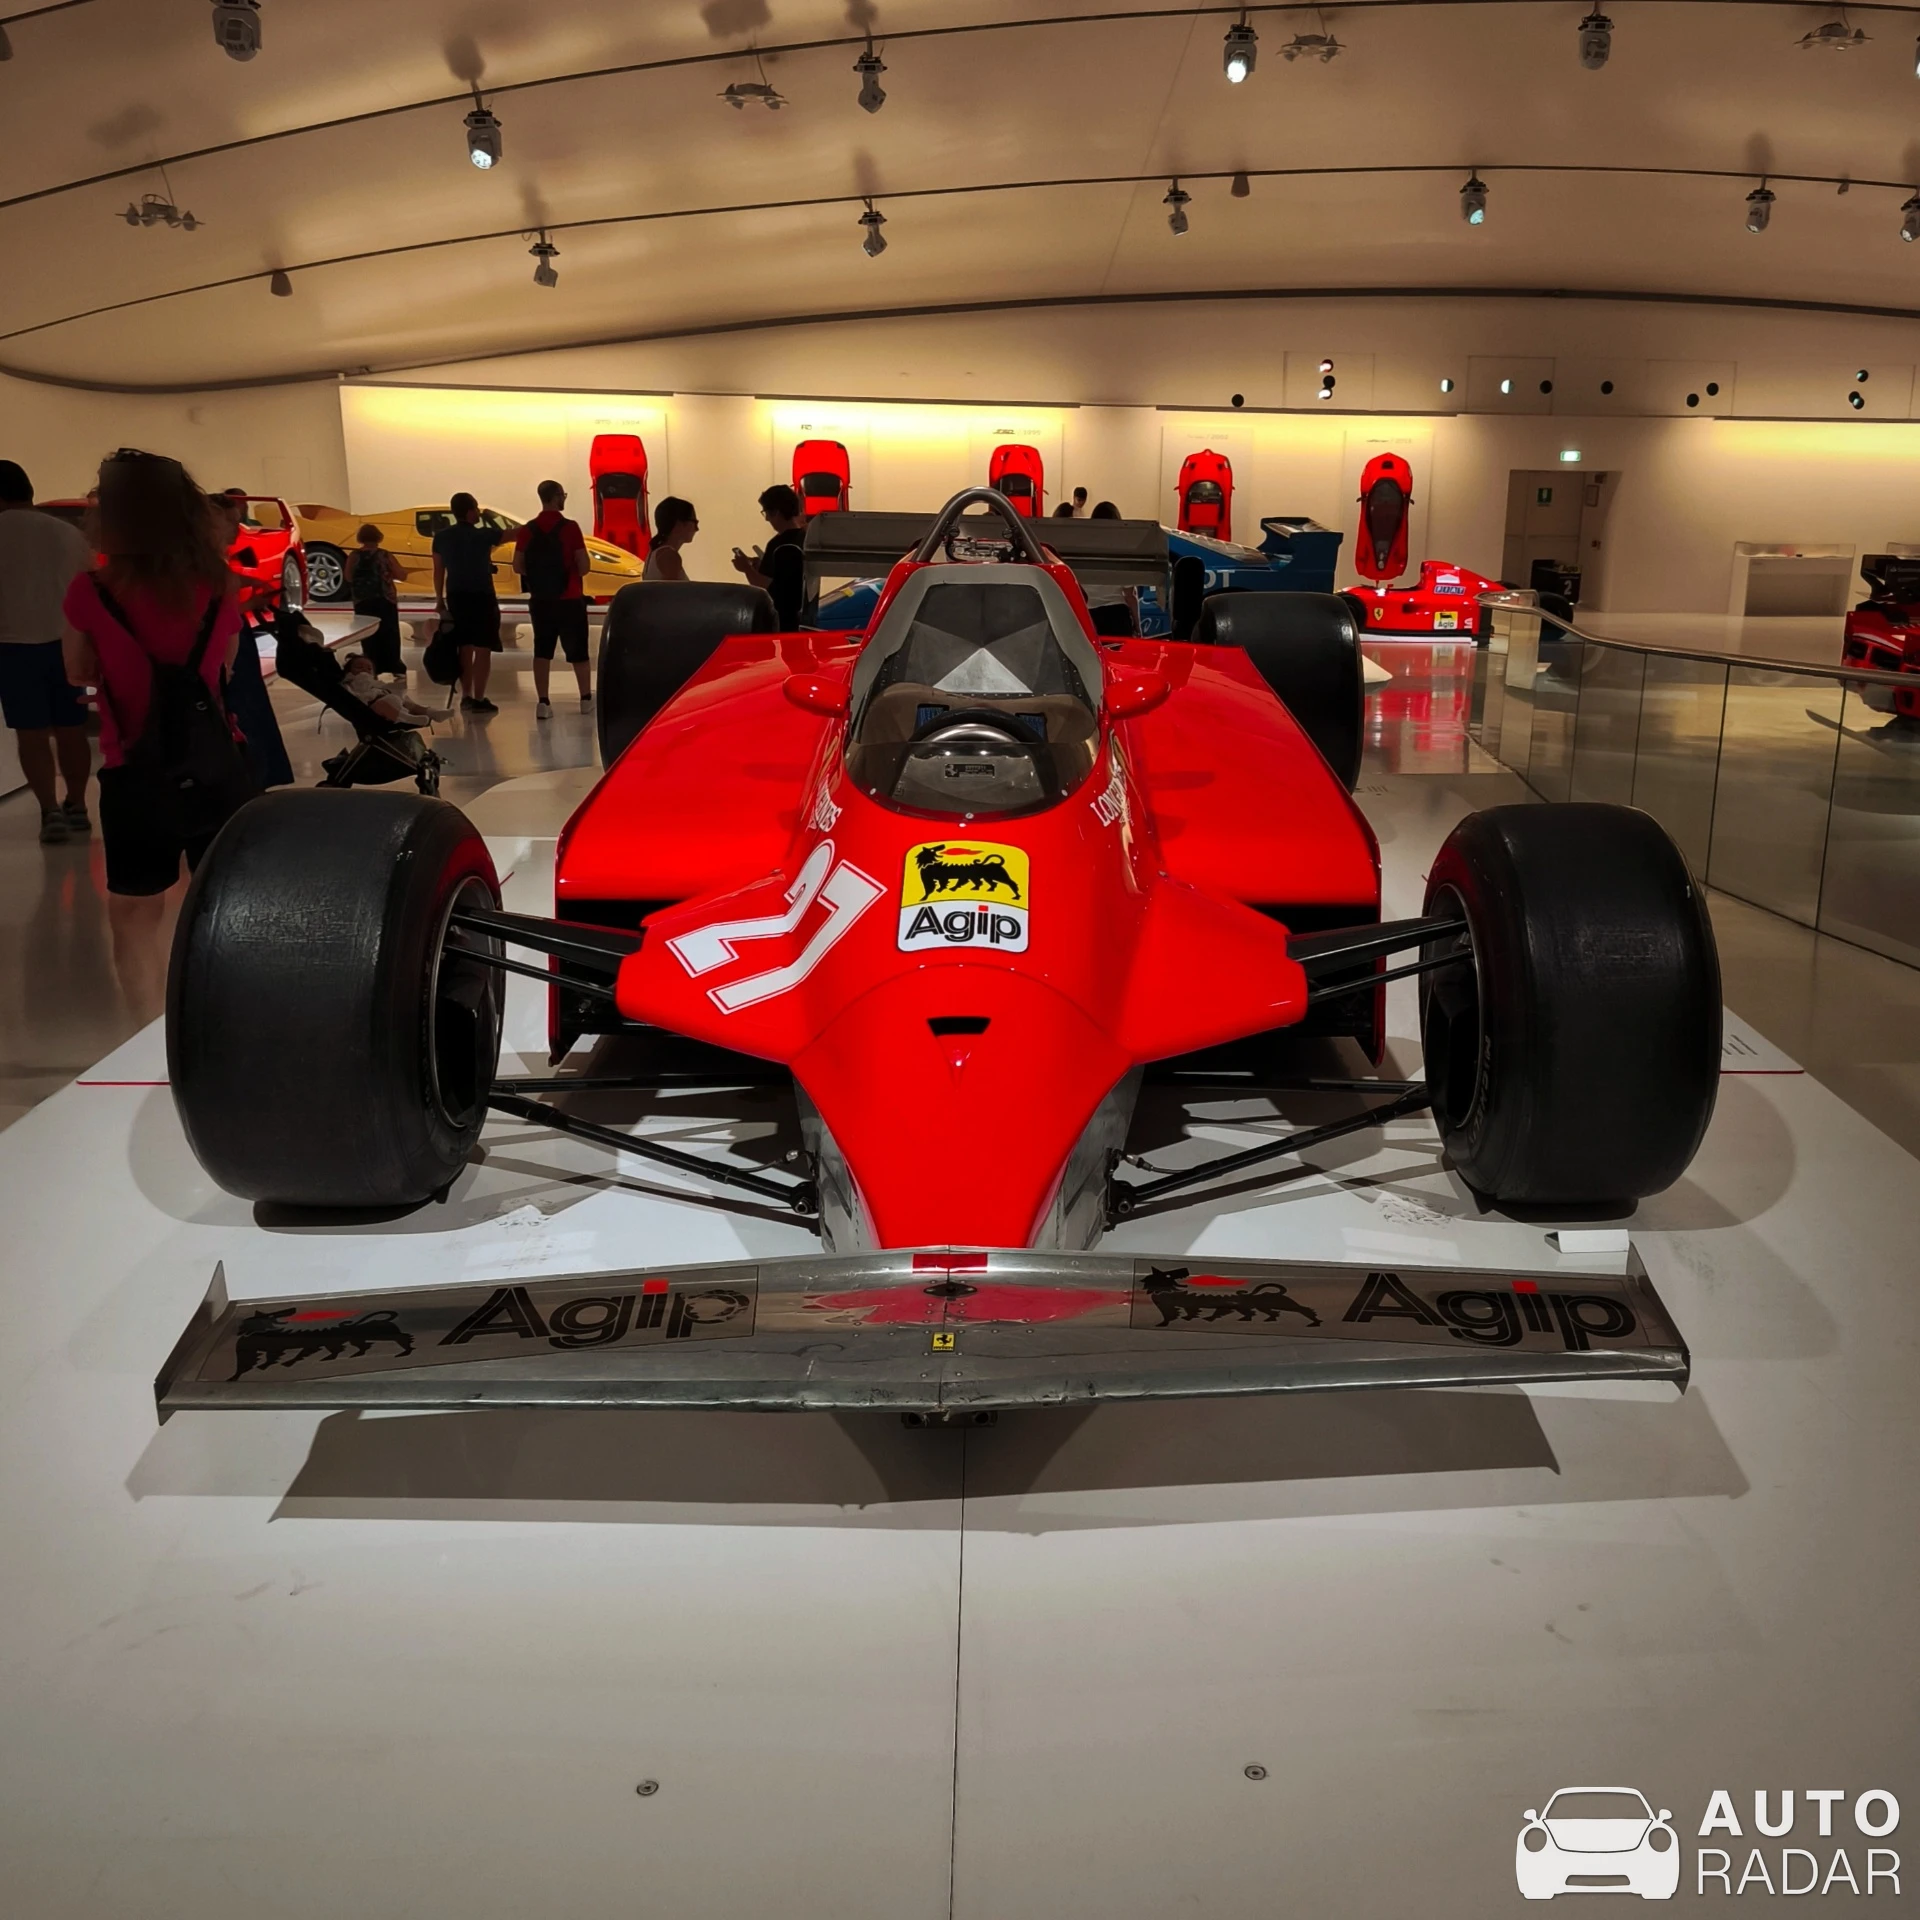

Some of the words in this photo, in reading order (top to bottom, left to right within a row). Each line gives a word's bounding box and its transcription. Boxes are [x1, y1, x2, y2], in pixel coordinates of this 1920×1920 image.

[1564, 580, 1572, 595] 2
[666, 838, 888, 1015] 27
[905, 904, 1021, 943] Agip
[438, 1279, 750, 1350] Agip
[1342, 1273, 1636, 1350] Agip
